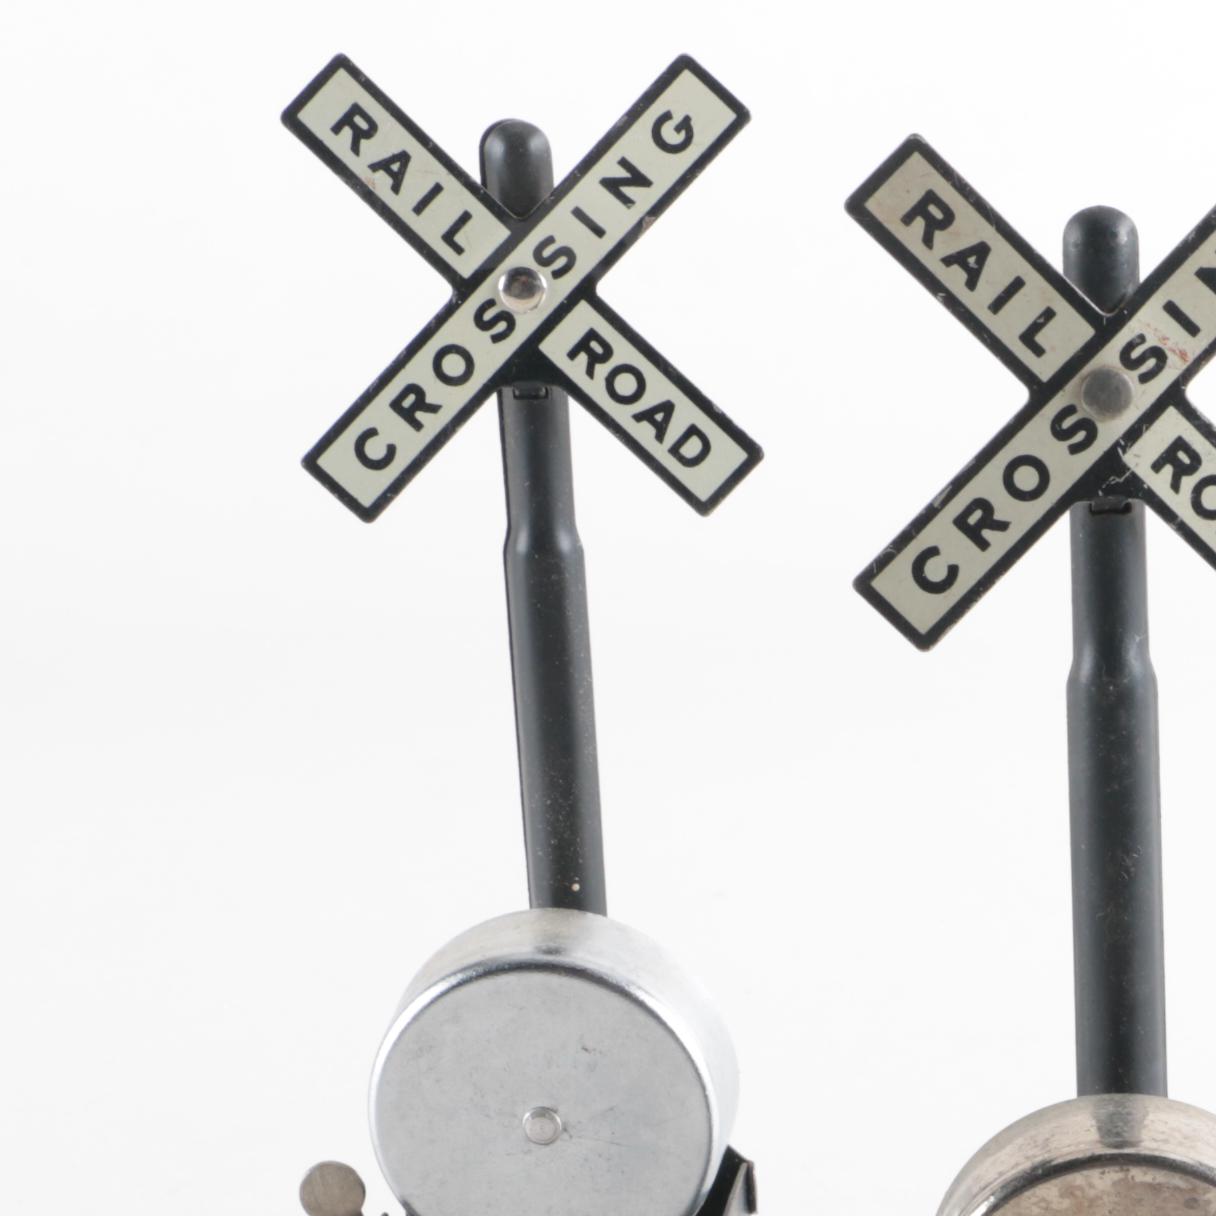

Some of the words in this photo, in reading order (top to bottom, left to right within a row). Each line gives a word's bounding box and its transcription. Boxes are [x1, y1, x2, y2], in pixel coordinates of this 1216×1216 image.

[329, 101, 473, 256] RAIL
[566, 327, 712, 468] ROAD
[353, 109, 695, 471] CROSSING
[901, 188, 1057, 358] RAIL
